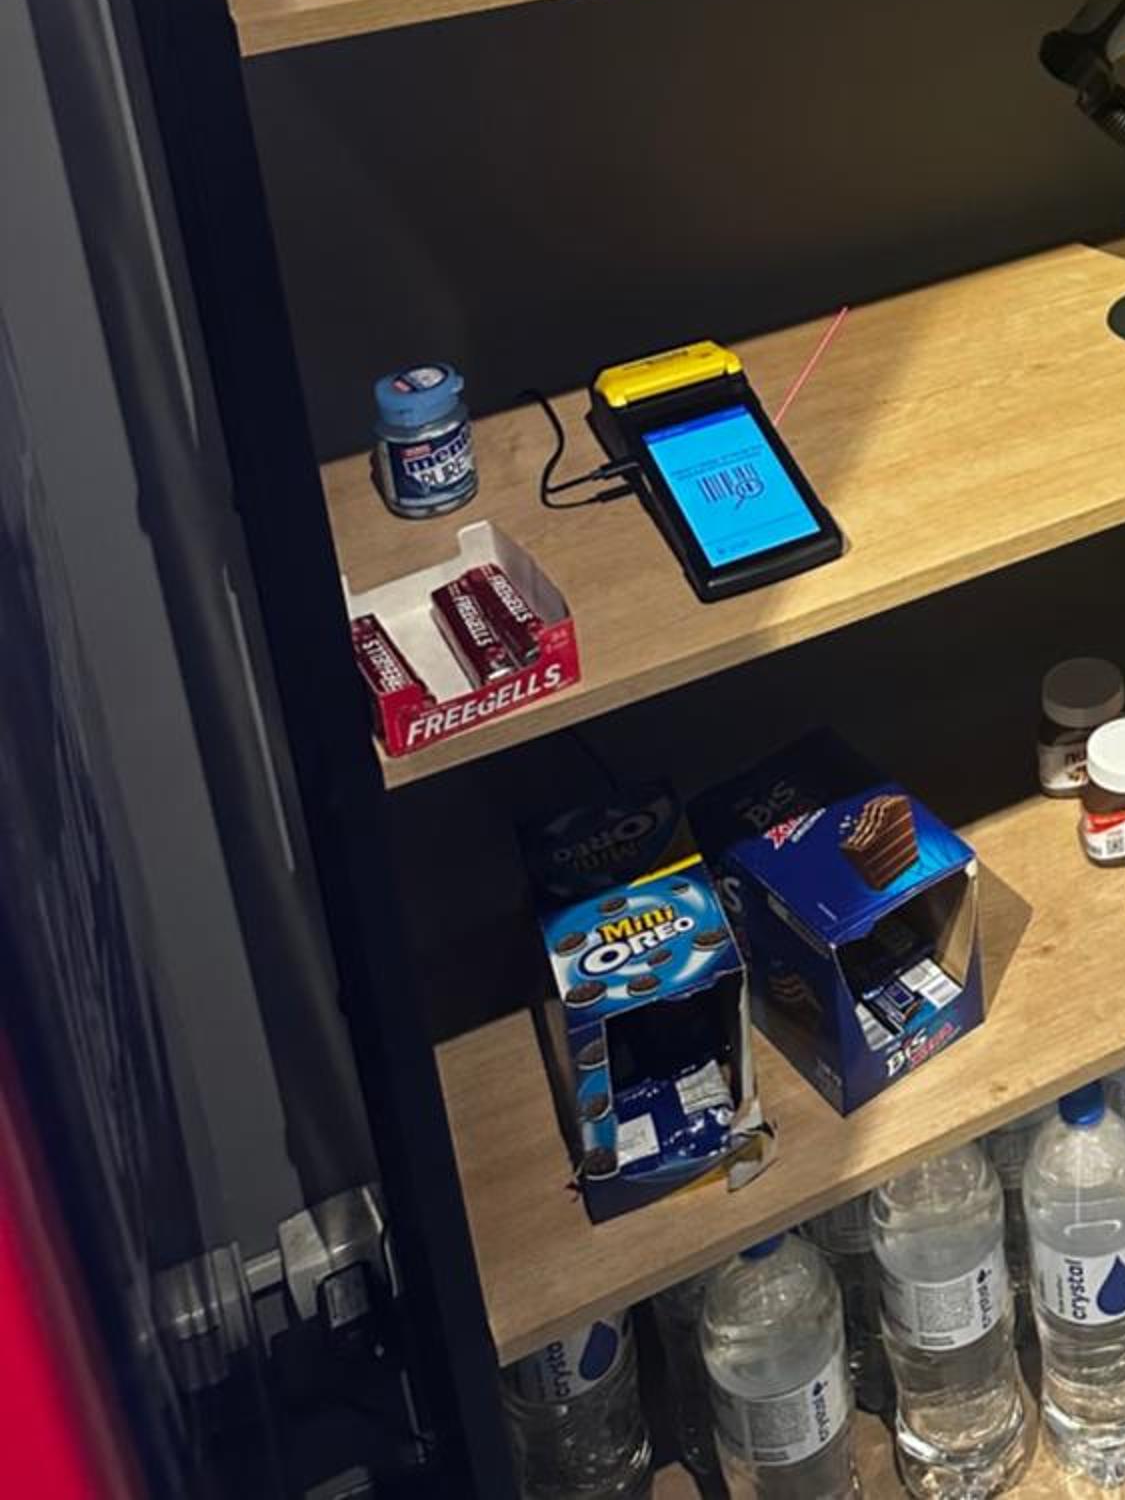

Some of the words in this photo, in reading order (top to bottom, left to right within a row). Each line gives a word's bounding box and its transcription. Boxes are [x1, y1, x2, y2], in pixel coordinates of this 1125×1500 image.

[406, 664, 562, 746] FREEGELLS
[579, 914, 697, 976] OREO
[598, 905, 676, 942] Mini
[1063, 1256, 1088, 1322] crystal
